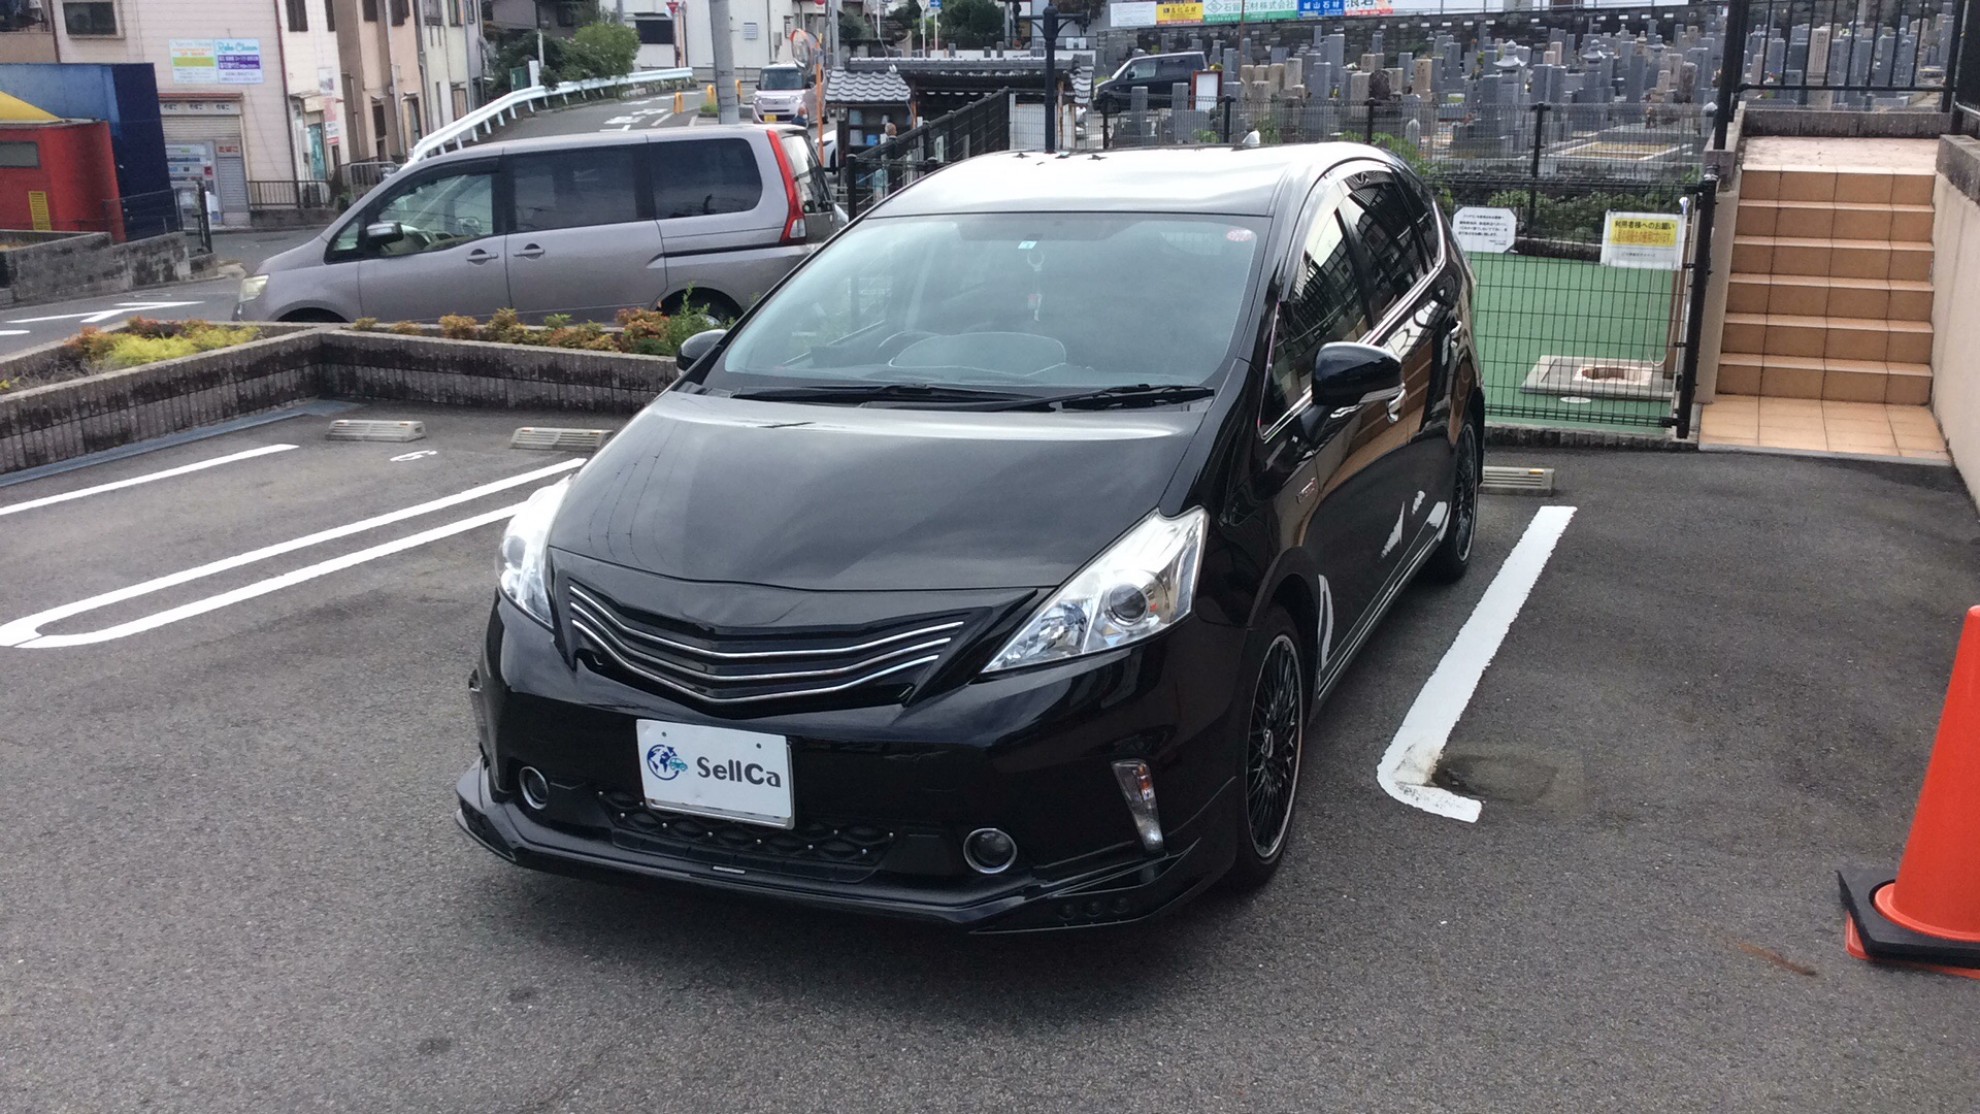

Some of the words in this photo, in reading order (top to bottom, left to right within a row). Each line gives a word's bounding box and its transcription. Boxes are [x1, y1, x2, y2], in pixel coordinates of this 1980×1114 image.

[1615, 220, 1675, 230] 利用者様へのお願い
[696, 756, 781, 788] SellCa
